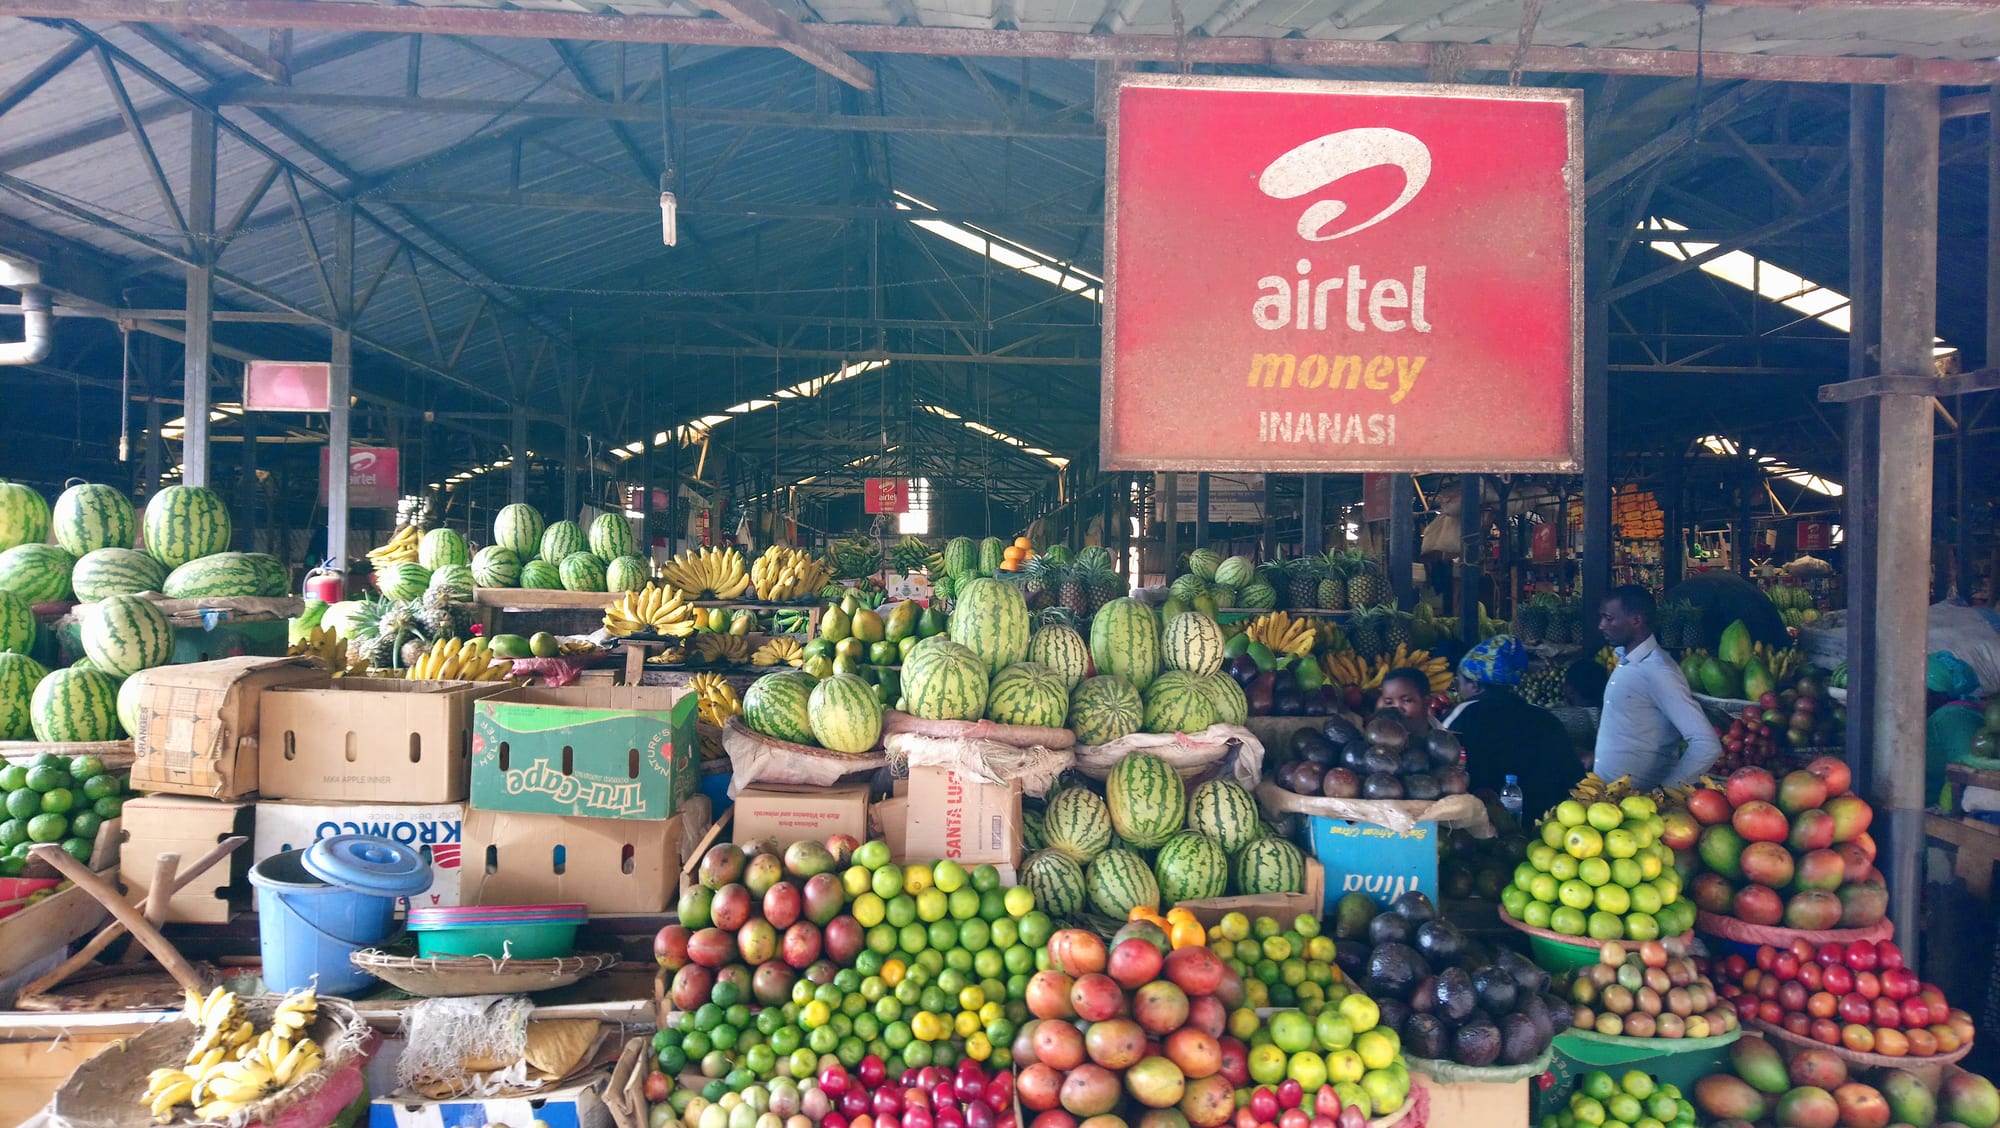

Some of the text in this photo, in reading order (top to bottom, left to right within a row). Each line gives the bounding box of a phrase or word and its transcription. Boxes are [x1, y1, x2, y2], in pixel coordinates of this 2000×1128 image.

[1252, 258, 1432, 333] airtel
[1246, 352, 1427, 404] money
[1258, 411, 1396, 446] INANASI
[138, 707, 148, 758] ORANGES
[479, 721, 499, 767] HELPER
[648, 728, 670, 777] NATURE'S
[341, 776, 365, 784] APPLE
[316, 821, 461, 845] KROMCO
[946, 808, 962, 858] SANTA
[1342, 873, 1419, 905] Nina
